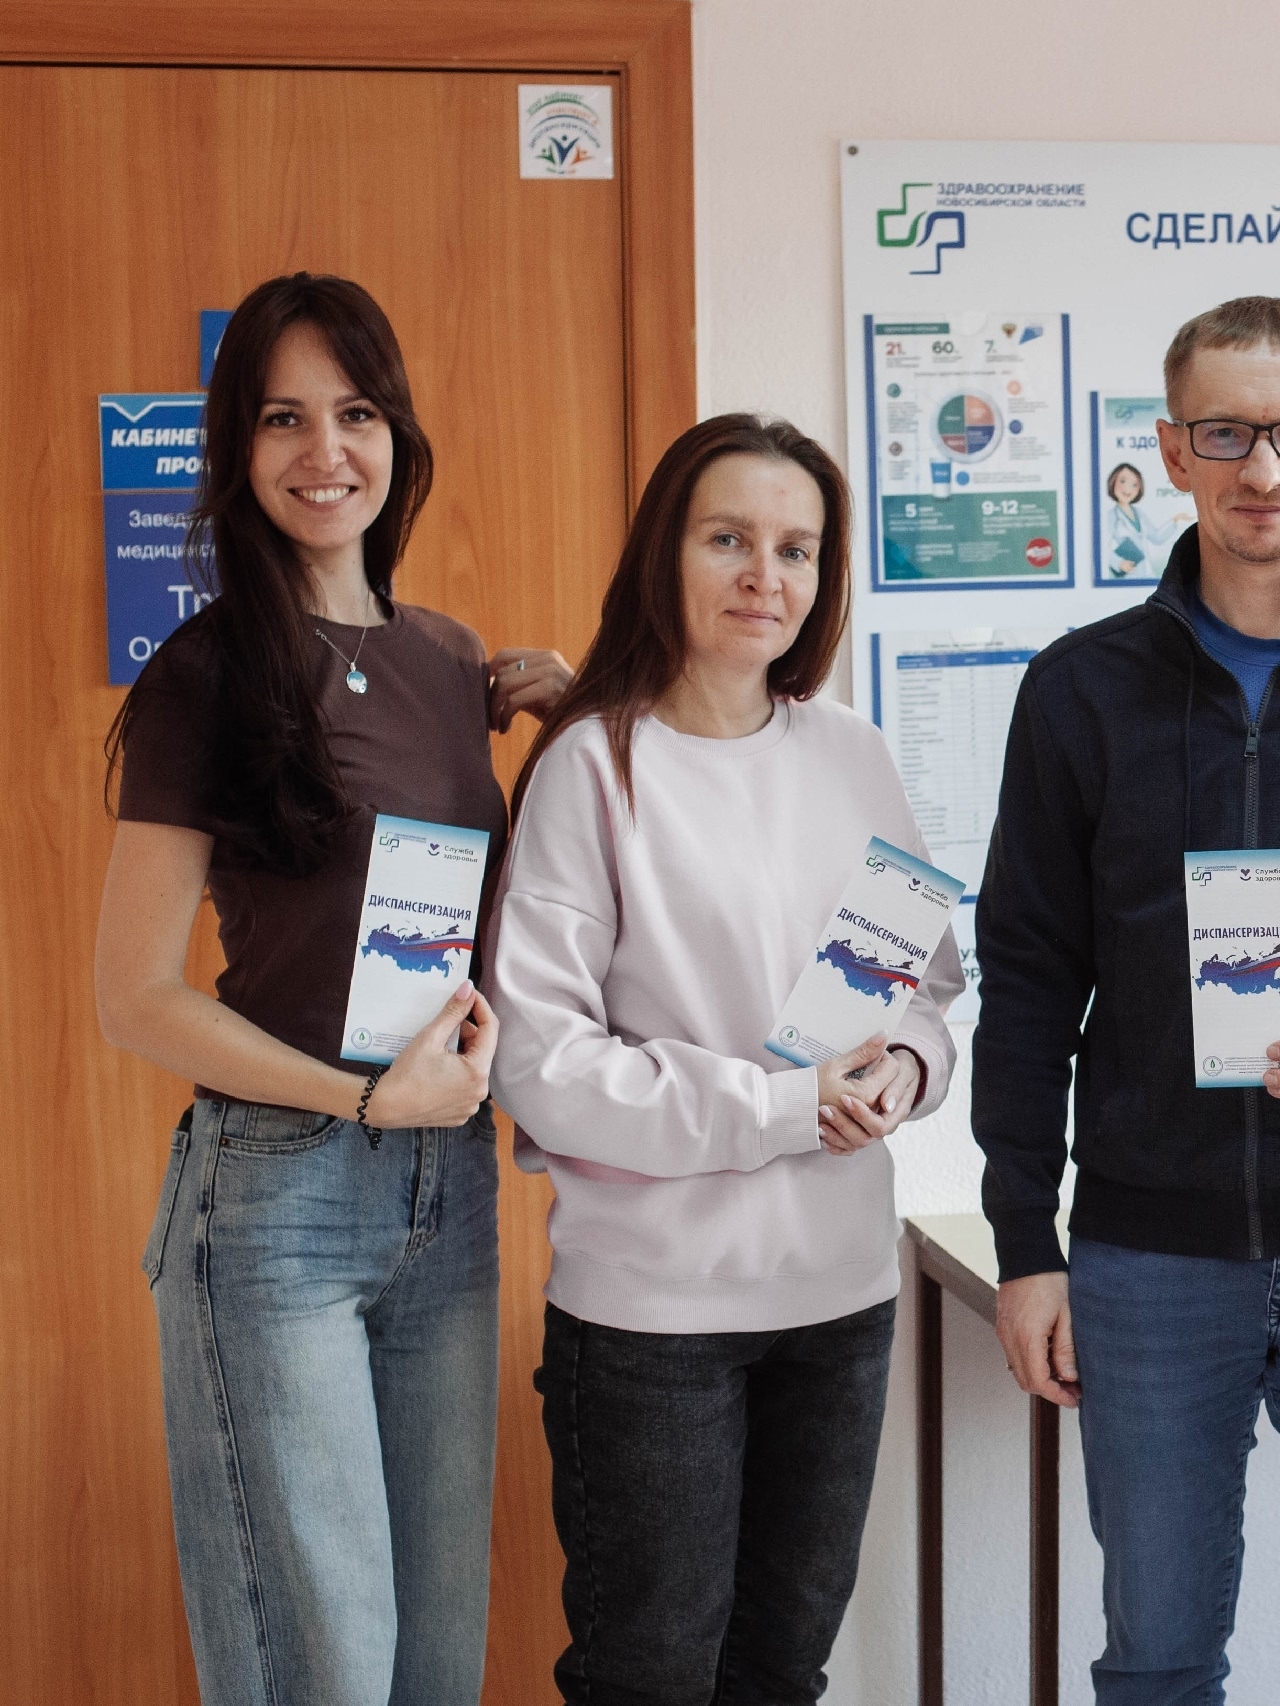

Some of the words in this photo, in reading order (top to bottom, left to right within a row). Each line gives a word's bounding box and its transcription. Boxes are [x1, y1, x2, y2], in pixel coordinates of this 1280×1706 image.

[937, 183, 1085, 196] ЗДРАВООХРАНЕНИЕ
[1129, 437, 1157, 449] ЗДО
[905, 503, 917, 518] 5
[982, 499, 1019, 515] 9-12
[443, 853, 478, 863] здоровья
[444, 845, 474, 856] Служба
[920, 891, 950, 910] здоровья
[924, 884, 949, 902] Служба
[368, 894, 472, 921] ДИСПАНСЕРИЗАЦИЯ
[837, 906, 929, 962] ДИСПАНСЕРИЗАЦИЯ
